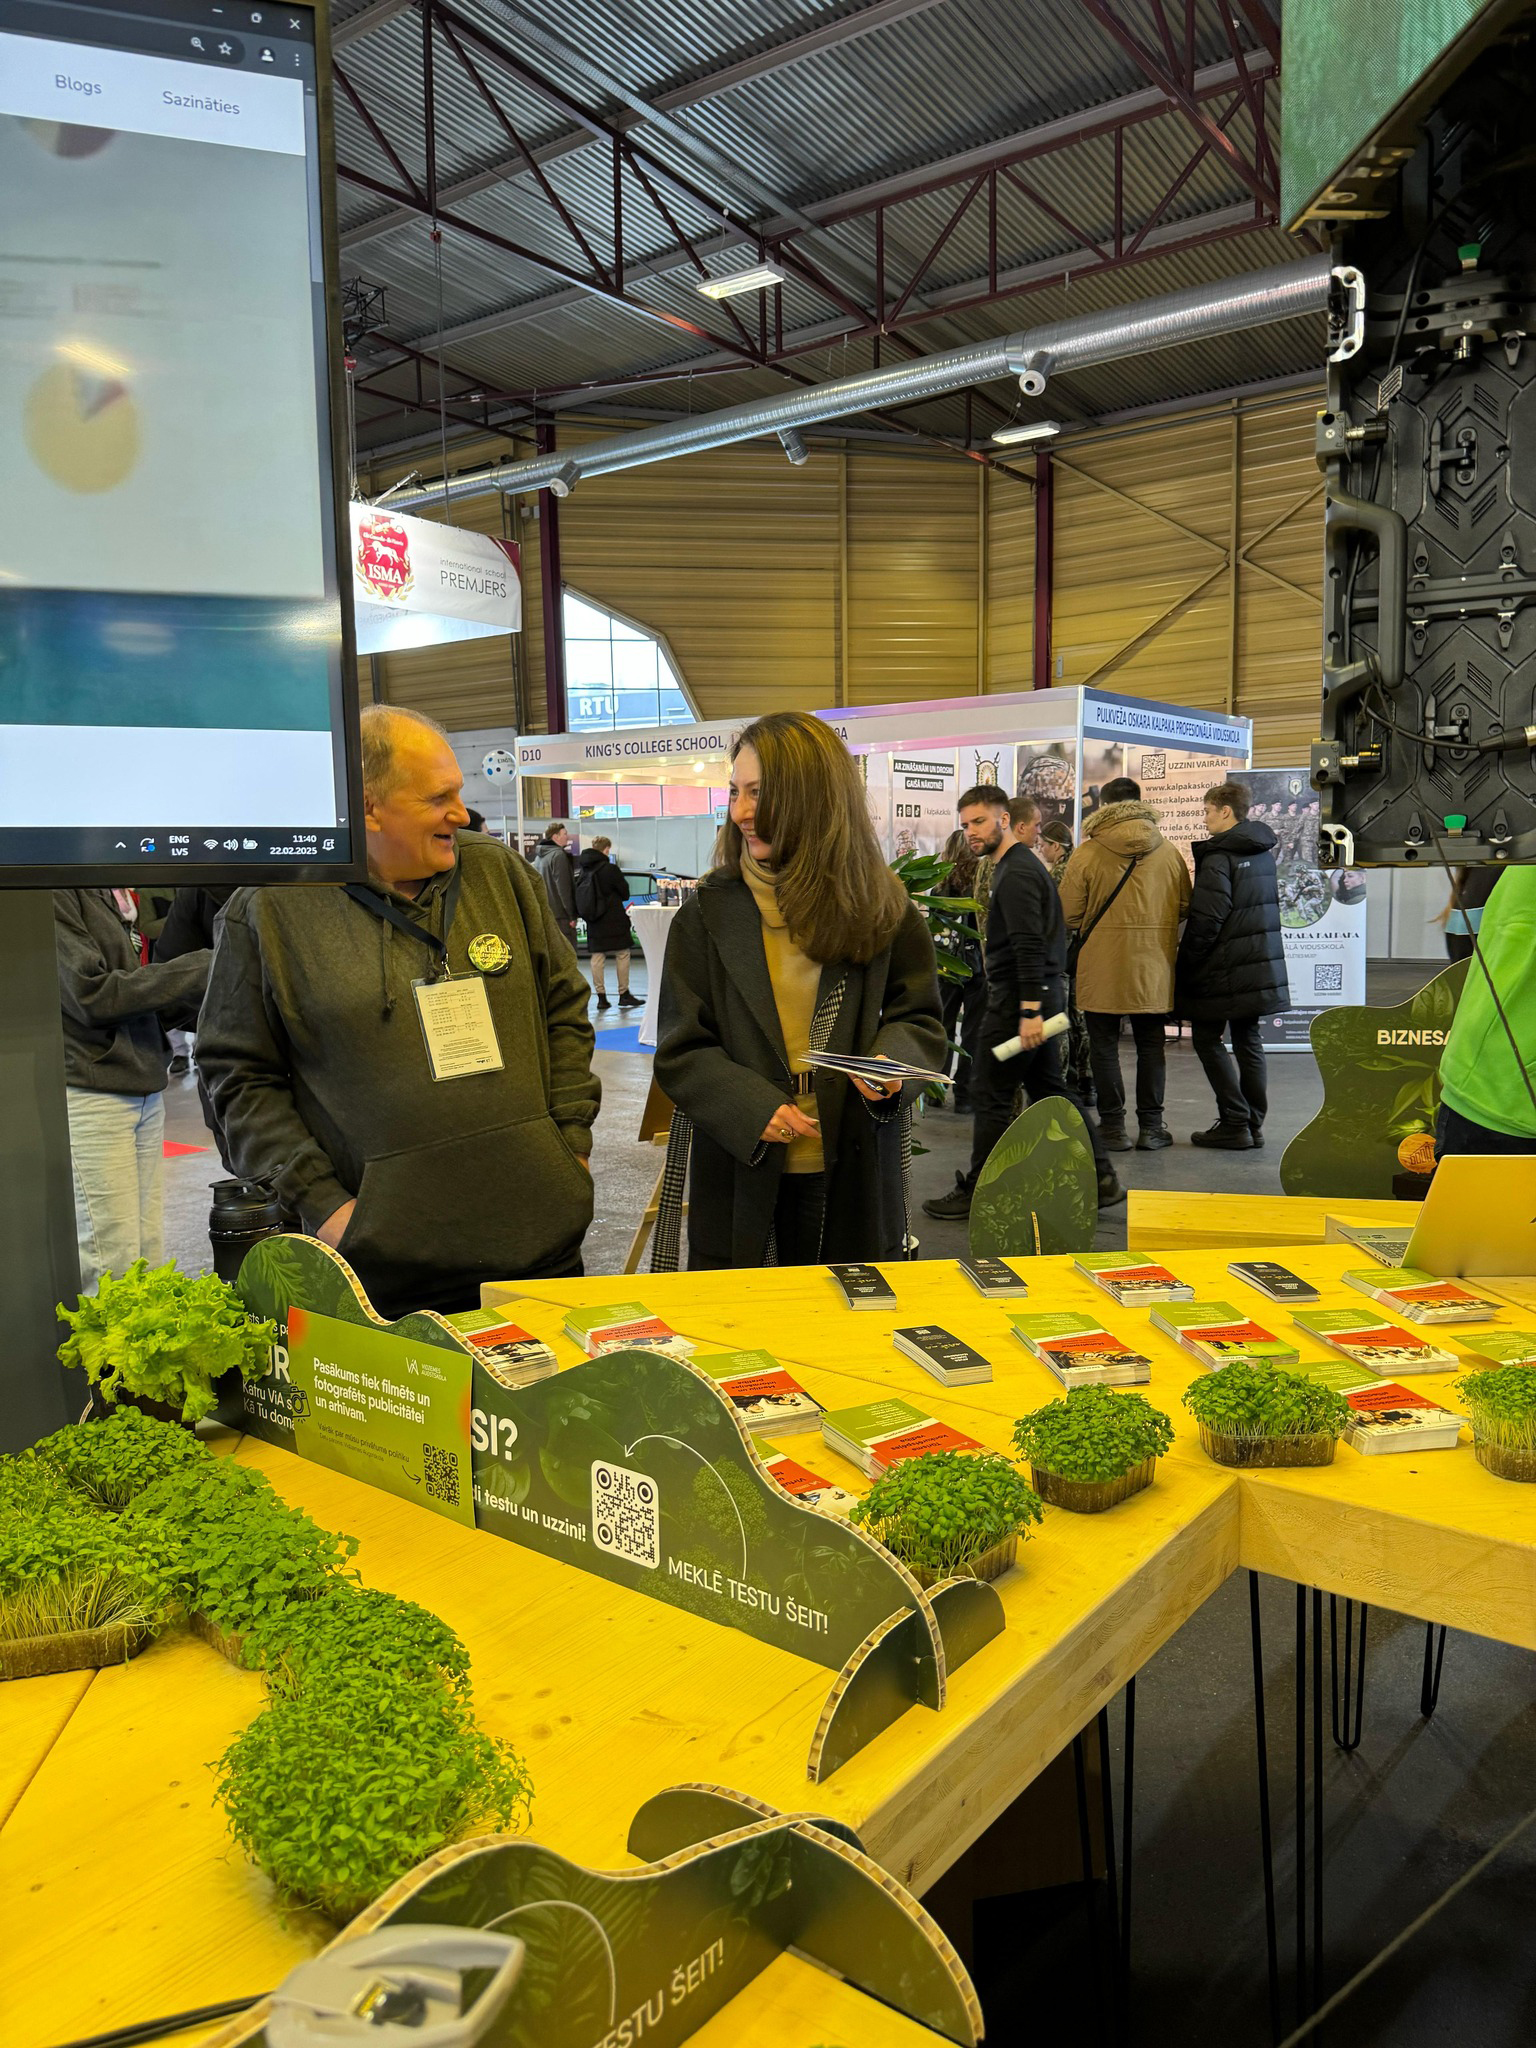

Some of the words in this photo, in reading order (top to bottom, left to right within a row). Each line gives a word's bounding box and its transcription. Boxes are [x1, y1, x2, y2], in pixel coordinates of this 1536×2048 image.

[55, 74, 102, 95] Blogs
[162, 90, 240, 115] Sazināties
[367, 563, 403, 585] ISMA
[440, 557, 482, 574] international
[485, 568, 507, 579] school
[440, 570, 507, 599] PREMJERS
[579, 695, 619, 717] RTU
[1096, 707, 1127, 726] PULKVEŽA
[1128, 712, 1150, 730] OSKARA
[1152, 716, 1175, 734] KALPAKA
[1176, 720, 1212, 739] PROFESIONĀLĀ
[1212, 728, 1240, 744] VIDUSSKOLA
[522, 749, 542, 762] D10
[585, 742, 622, 759] KING'S
[624, 738, 673, 757] COLLEGE
[675, 735, 728, 752] SCHOOL,
[1168, 762, 1195, 770] UZZINI
[1196, 759, 1228, 768] VAIRĀK!
[169, 836, 190, 844] ENG
[269, 846, 318, 856] 22.02.2025
[292, 835, 318, 844] 11:40
[171, 848, 189, 857] LVS
[313, 1357, 360, 1384] Pasākums
[362, 1372, 380, 1392] tiek
[382, 1378, 416, 1402] filmēts
[417, 1391, 430, 1407] un
[243, 1380, 266, 1401] Katru
[268, 1388, 284, 1408] ViA
[314, 1376, 366, 1405] fotografēts
[368, 1396, 425, 1424] publicitātei
[243, 1397, 255, 1414] Kā
[256, 1402, 268, 1420] Tu
[315, 1396, 327, 1409] un
[328, 1400, 367, 1422] arhīvam.
[334, 1429, 344, 1440] par
[485, 1489, 518, 1516] testu
[522, 1506, 538, 1524] un
[543, 1514, 586, 1542] uzzini!
[668, 1556, 723, 1595] MEKLĒ
[727, 1578, 780, 1616] TESTU
[786, 1596, 830, 1636] ŠEIT!
[592, 1989, 664, 2048] ESTU
[670, 1937, 724, 2006] ŠEIT!
